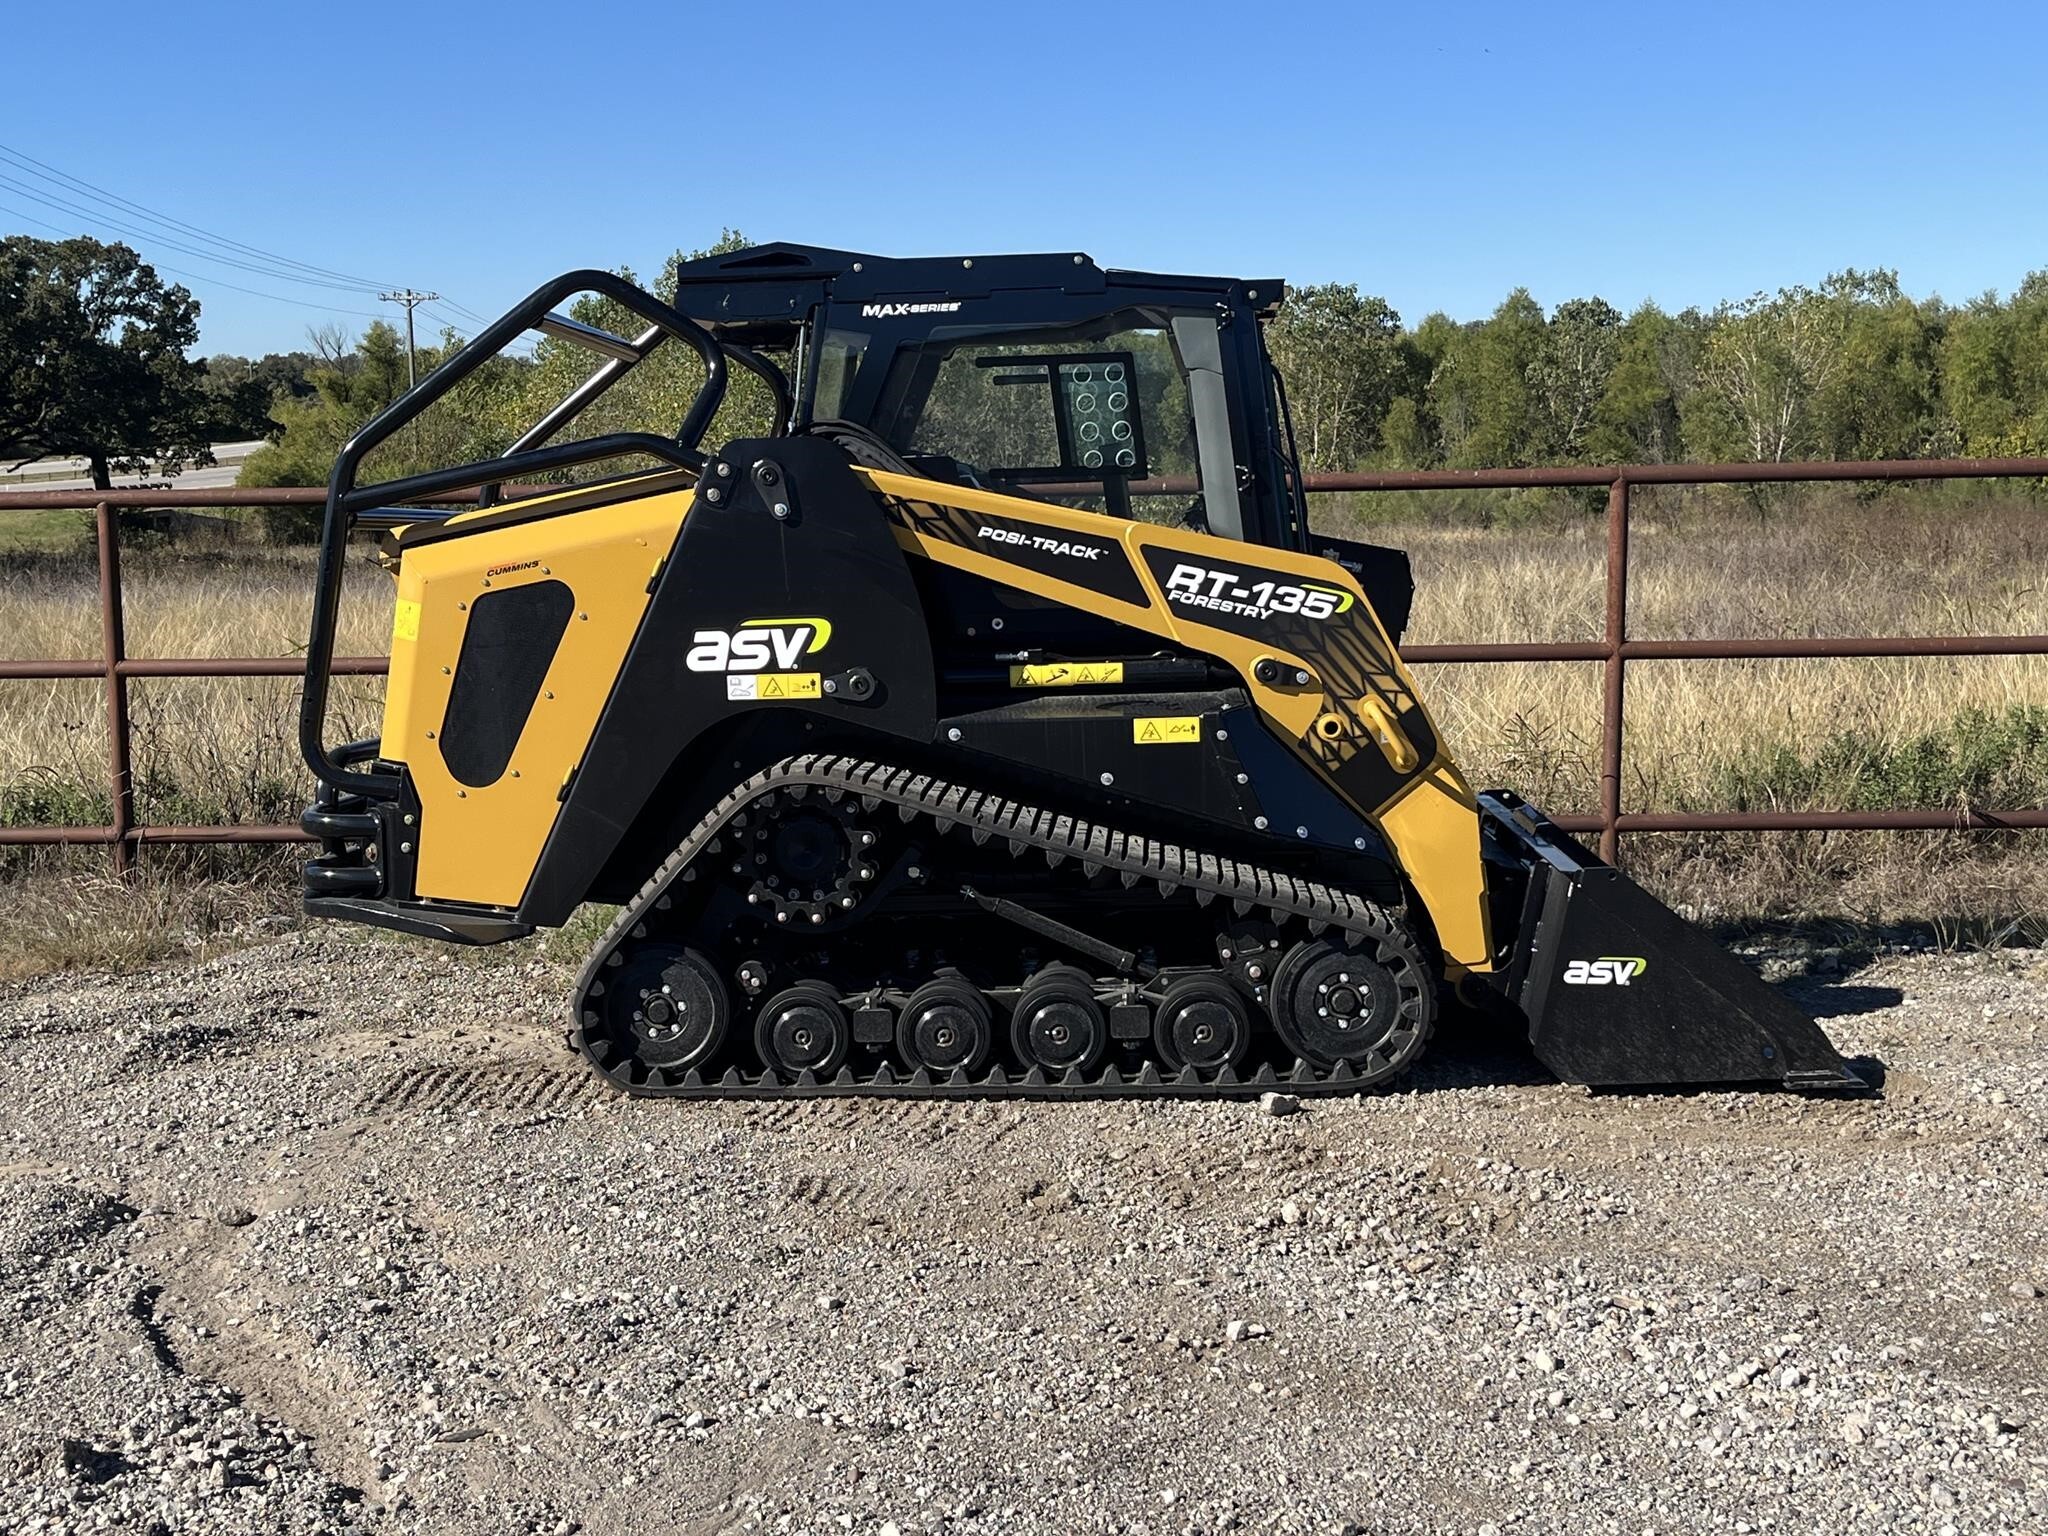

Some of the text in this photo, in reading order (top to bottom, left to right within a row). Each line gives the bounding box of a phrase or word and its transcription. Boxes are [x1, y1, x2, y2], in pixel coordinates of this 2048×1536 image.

[862, 302, 960, 318] MAX-SERIES
[977, 526, 1101, 560] POSI-TRACK
[487, 560, 539, 577] CUMMINS
[1165, 563, 1338, 620] RT-135
[1168, 590, 1274, 620] FORESTRY
